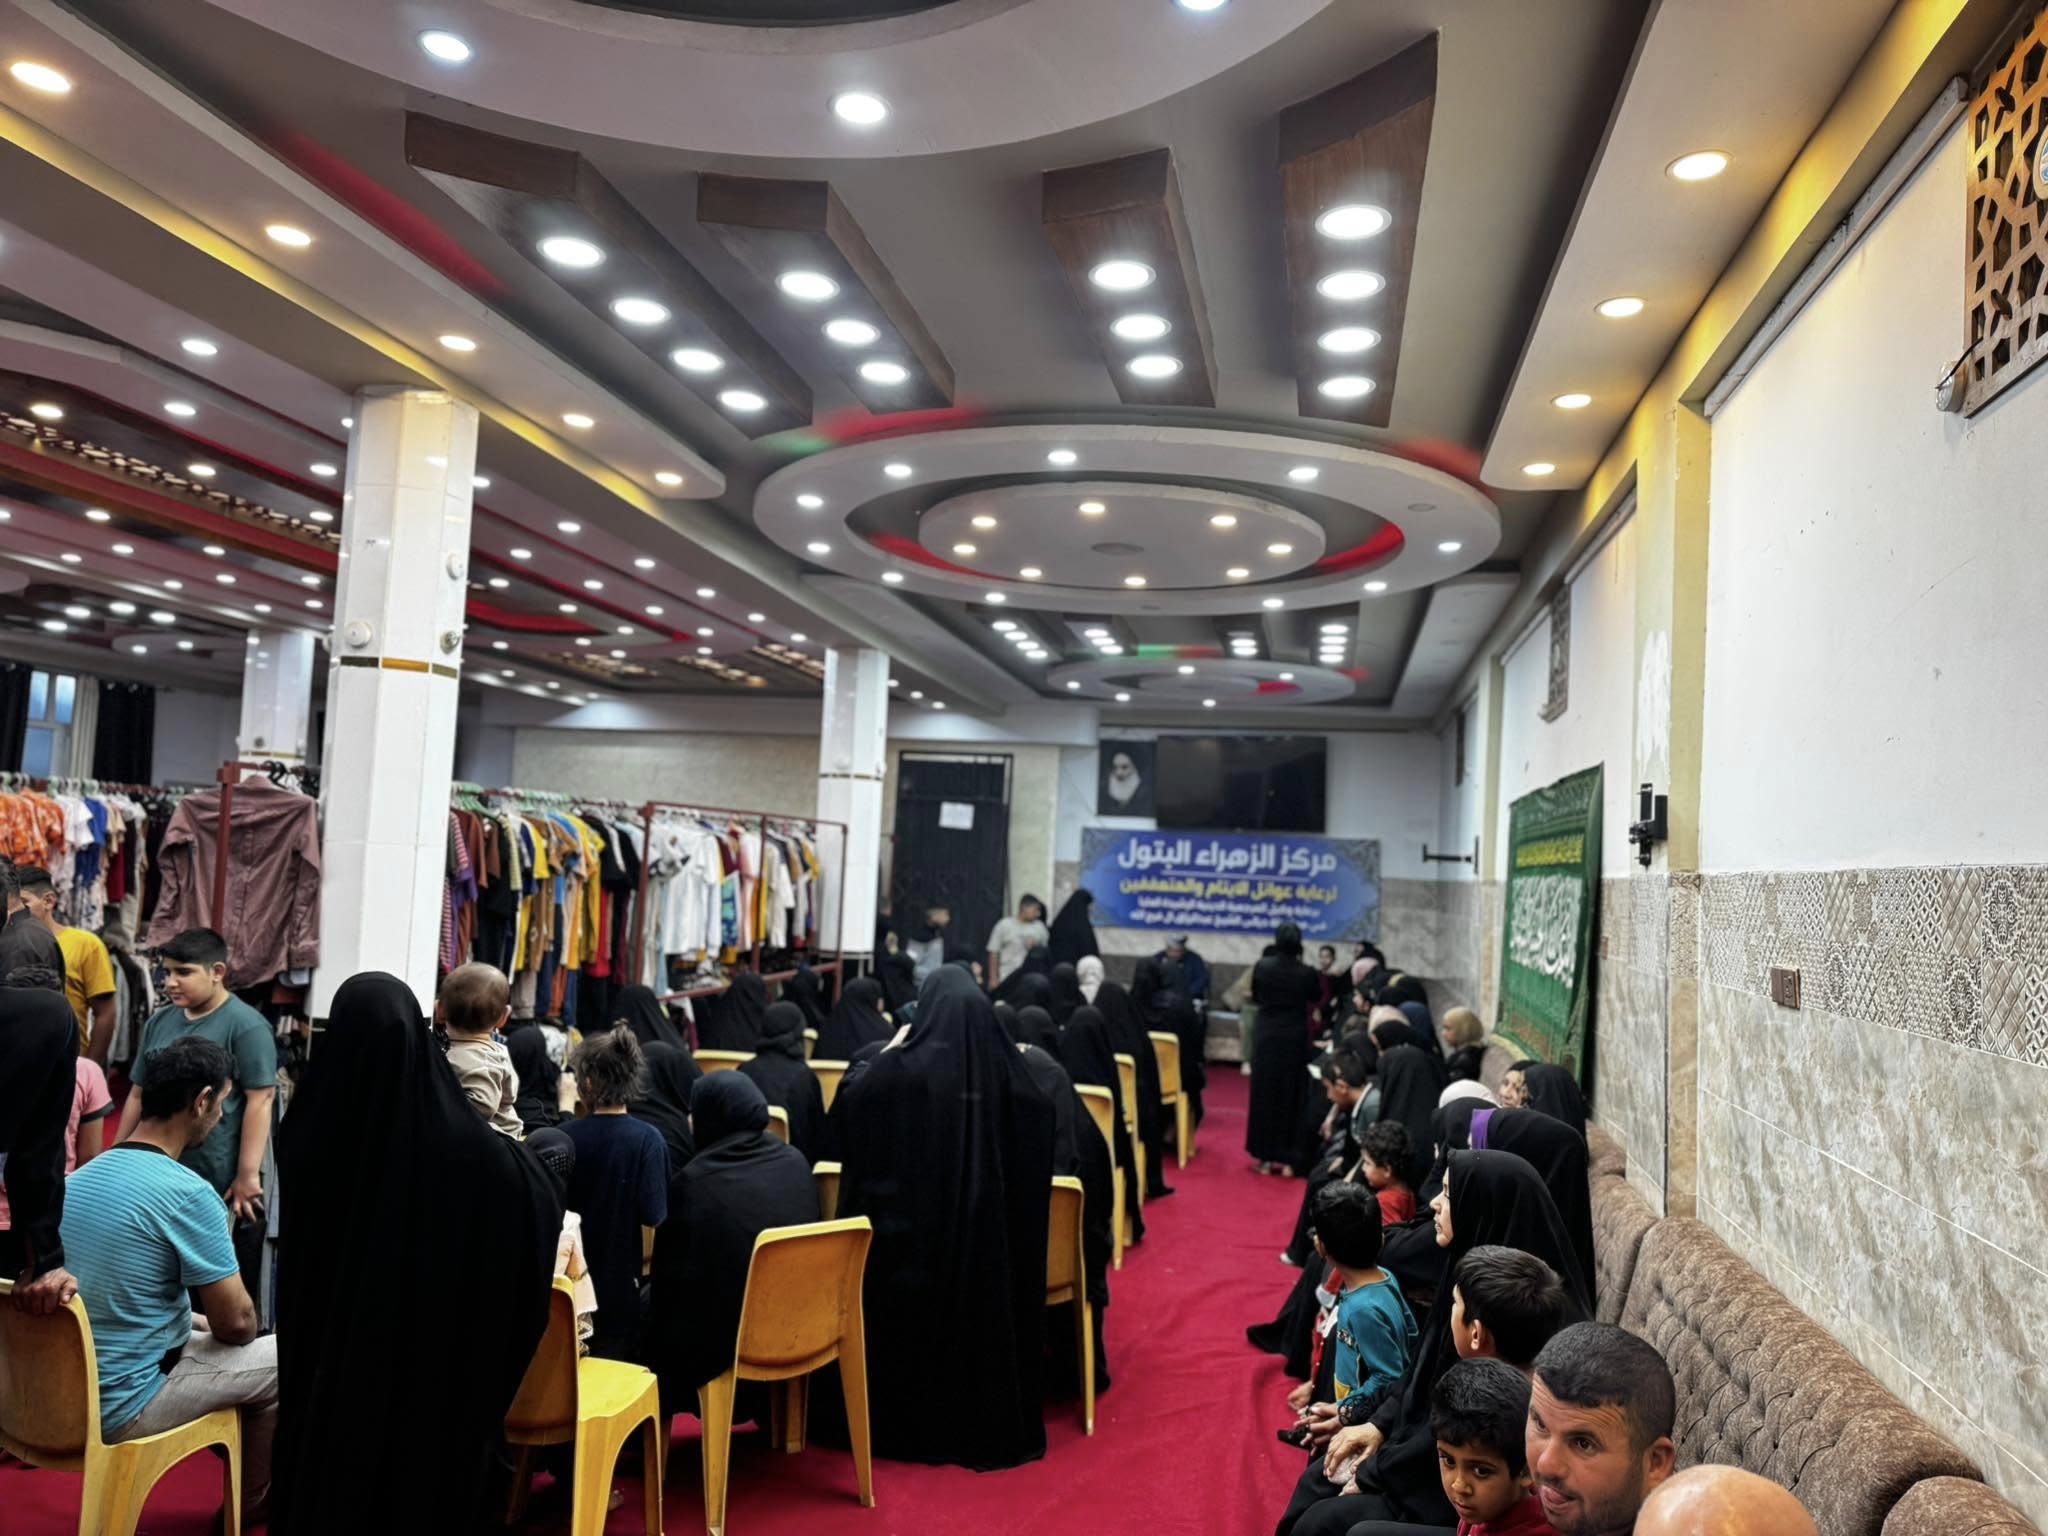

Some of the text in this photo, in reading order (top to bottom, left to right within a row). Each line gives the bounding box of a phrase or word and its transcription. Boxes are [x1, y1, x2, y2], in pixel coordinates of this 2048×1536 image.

[1117, 837, 1338, 878] مركز الزهراء البتول
